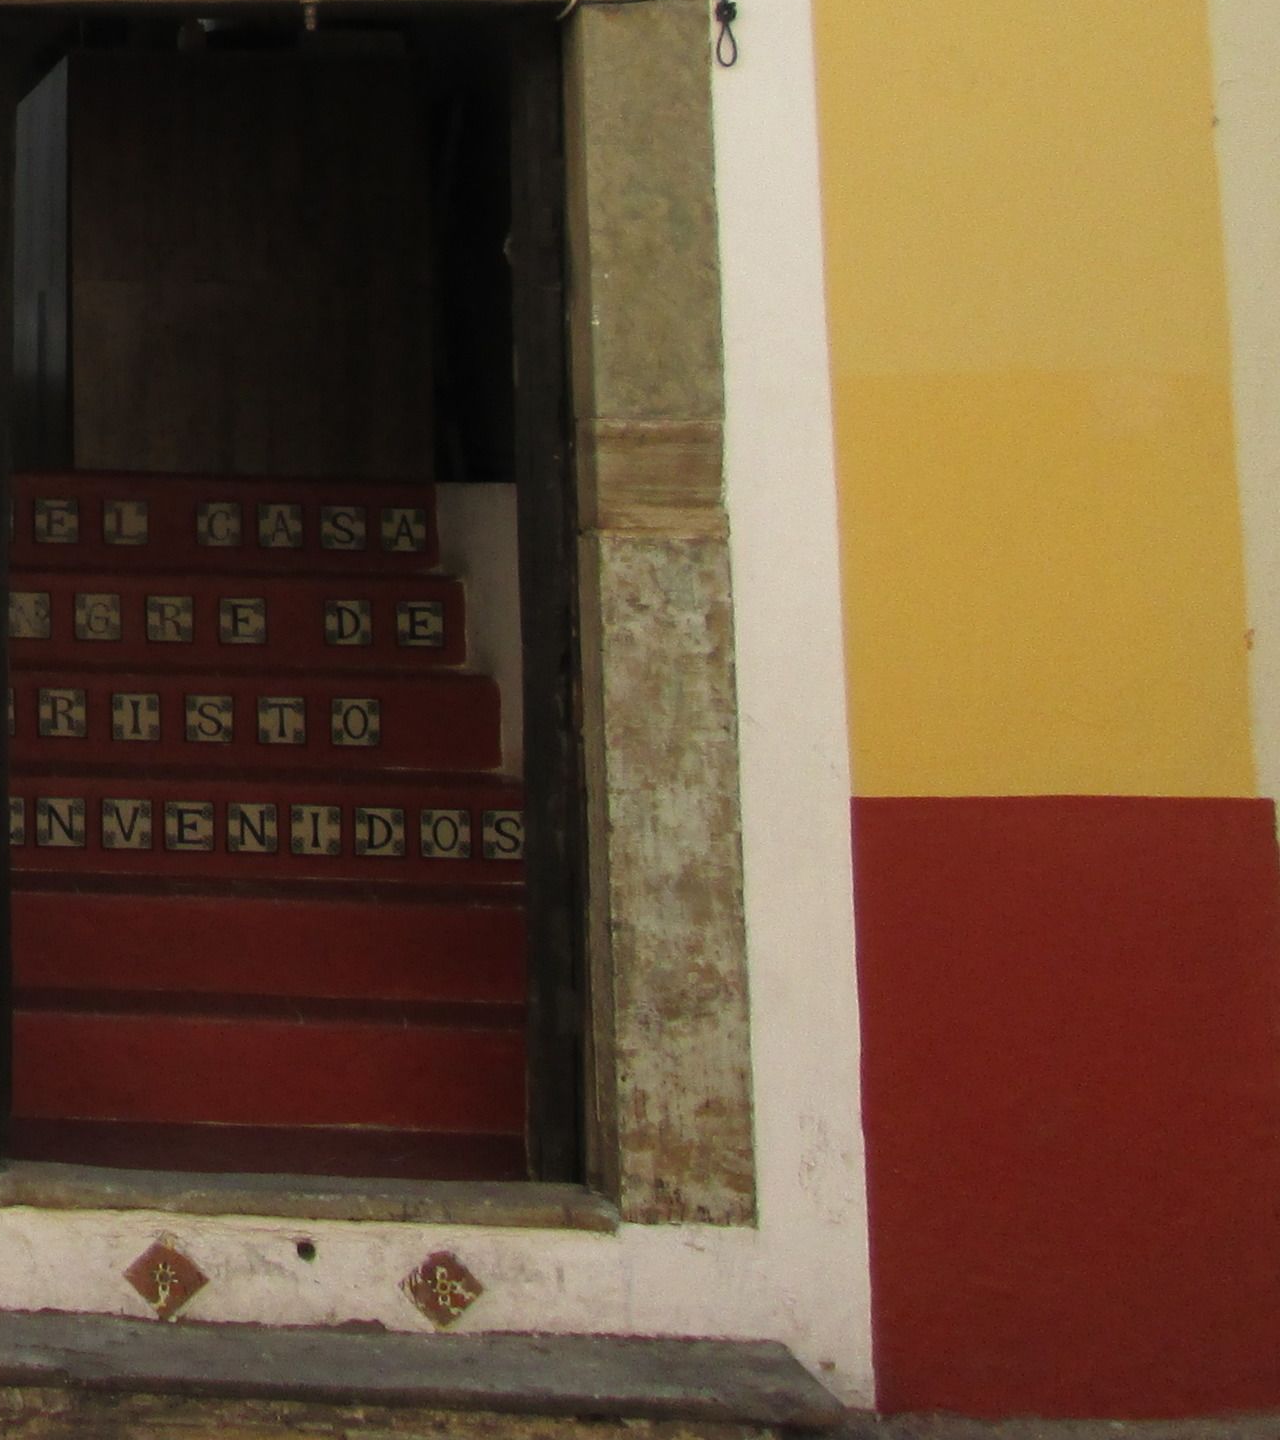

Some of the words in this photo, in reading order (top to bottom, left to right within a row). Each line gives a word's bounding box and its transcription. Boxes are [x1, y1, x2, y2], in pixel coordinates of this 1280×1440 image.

[207, 509, 416, 548] CASA
[337, 606, 434, 640] DE
[10, 804, 521, 854] NVENIDOS
